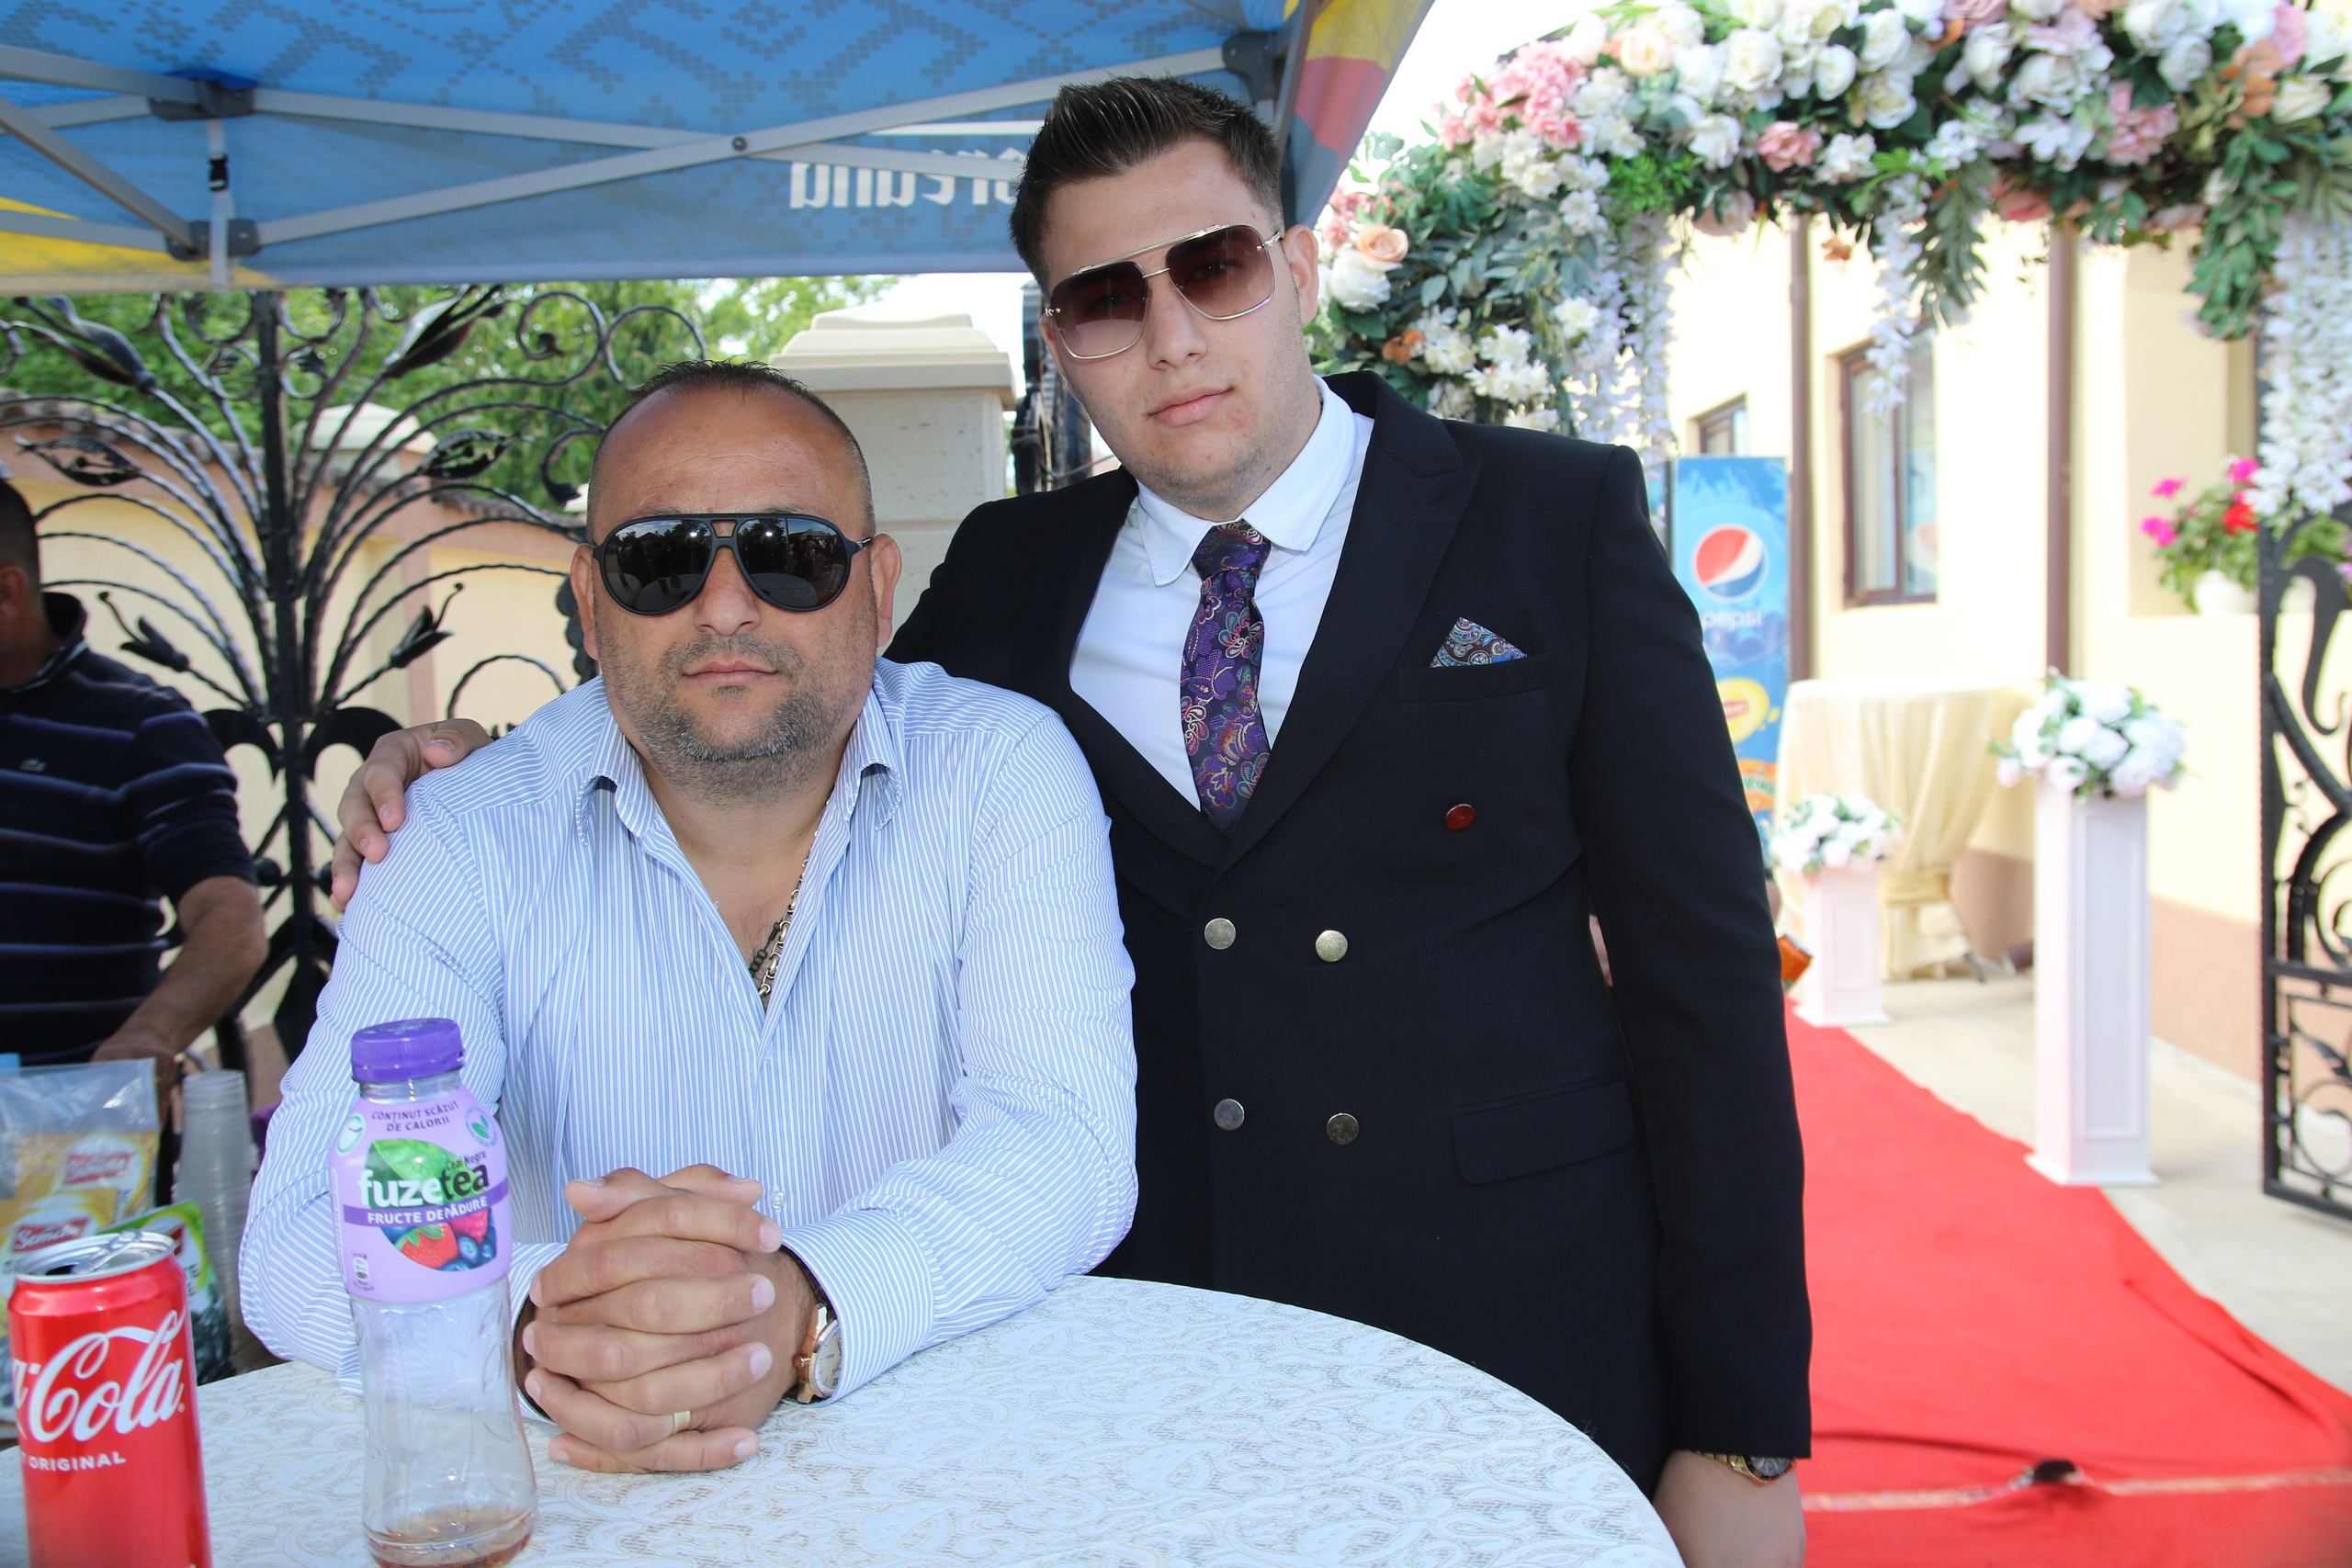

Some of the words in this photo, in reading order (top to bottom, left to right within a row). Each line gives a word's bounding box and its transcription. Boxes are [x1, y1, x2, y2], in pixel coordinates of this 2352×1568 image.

[1702, 607, 1761, 631] pepsi
[386, 1122, 401, 1133] DE
[405, 1116, 450, 1132] CALORII
[368, 1211, 423, 1224] FRUCTE
[426, 1208, 444, 1222] DE
[28, 1451, 126, 1472] ORIGINAL
